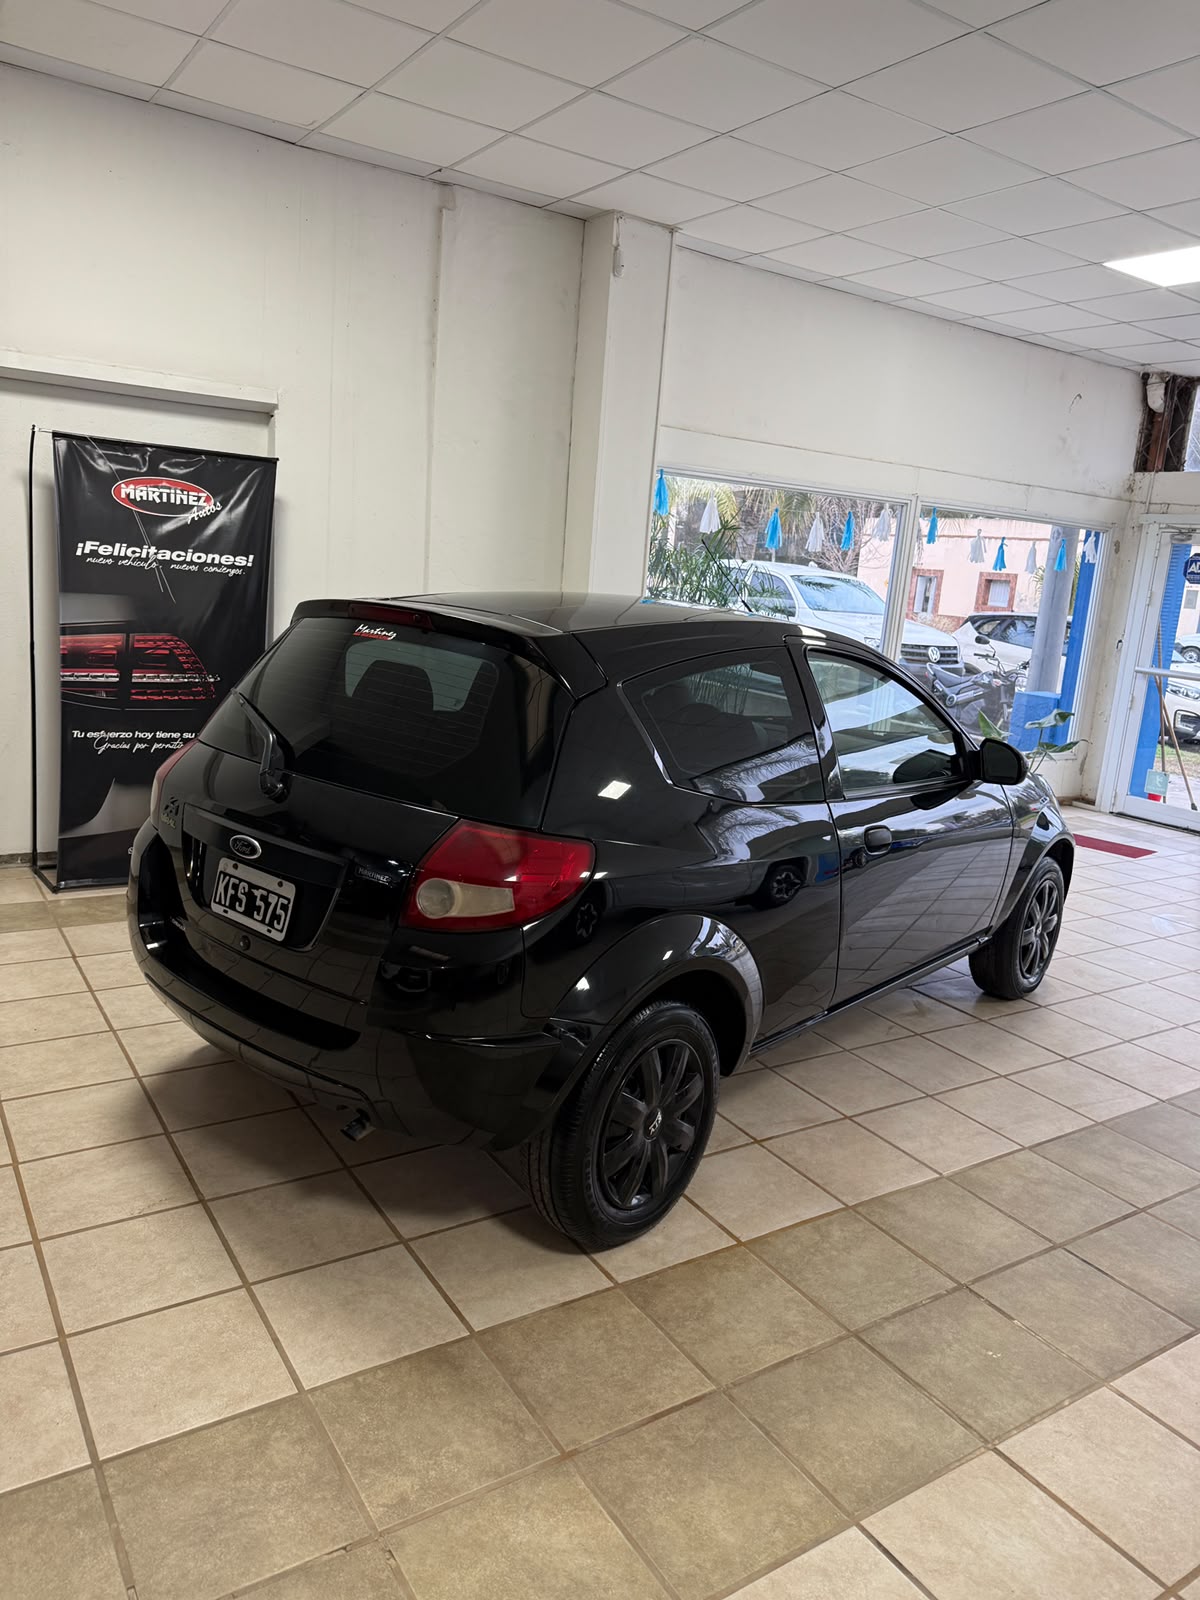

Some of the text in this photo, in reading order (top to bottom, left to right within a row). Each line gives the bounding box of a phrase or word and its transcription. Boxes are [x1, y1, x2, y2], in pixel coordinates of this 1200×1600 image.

[120, 483, 208, 507] MARTINEZ
[187, 500, 222, 525] Autos
[75, 540, 255, 567] ¡Felicitaciones!
[86, 557, 115, 565] nuevo
[72, 730, 85, 738] Tu
[87, 730, 133, 738] esfuerzo
[134, 730, 154, 740] hoy
[155, 731, 181, 739] tiene
[93, 734, 131, 755] Gracias
[132, 742, 150, 753] por
[215, 873, 289, 930] KFS 575
